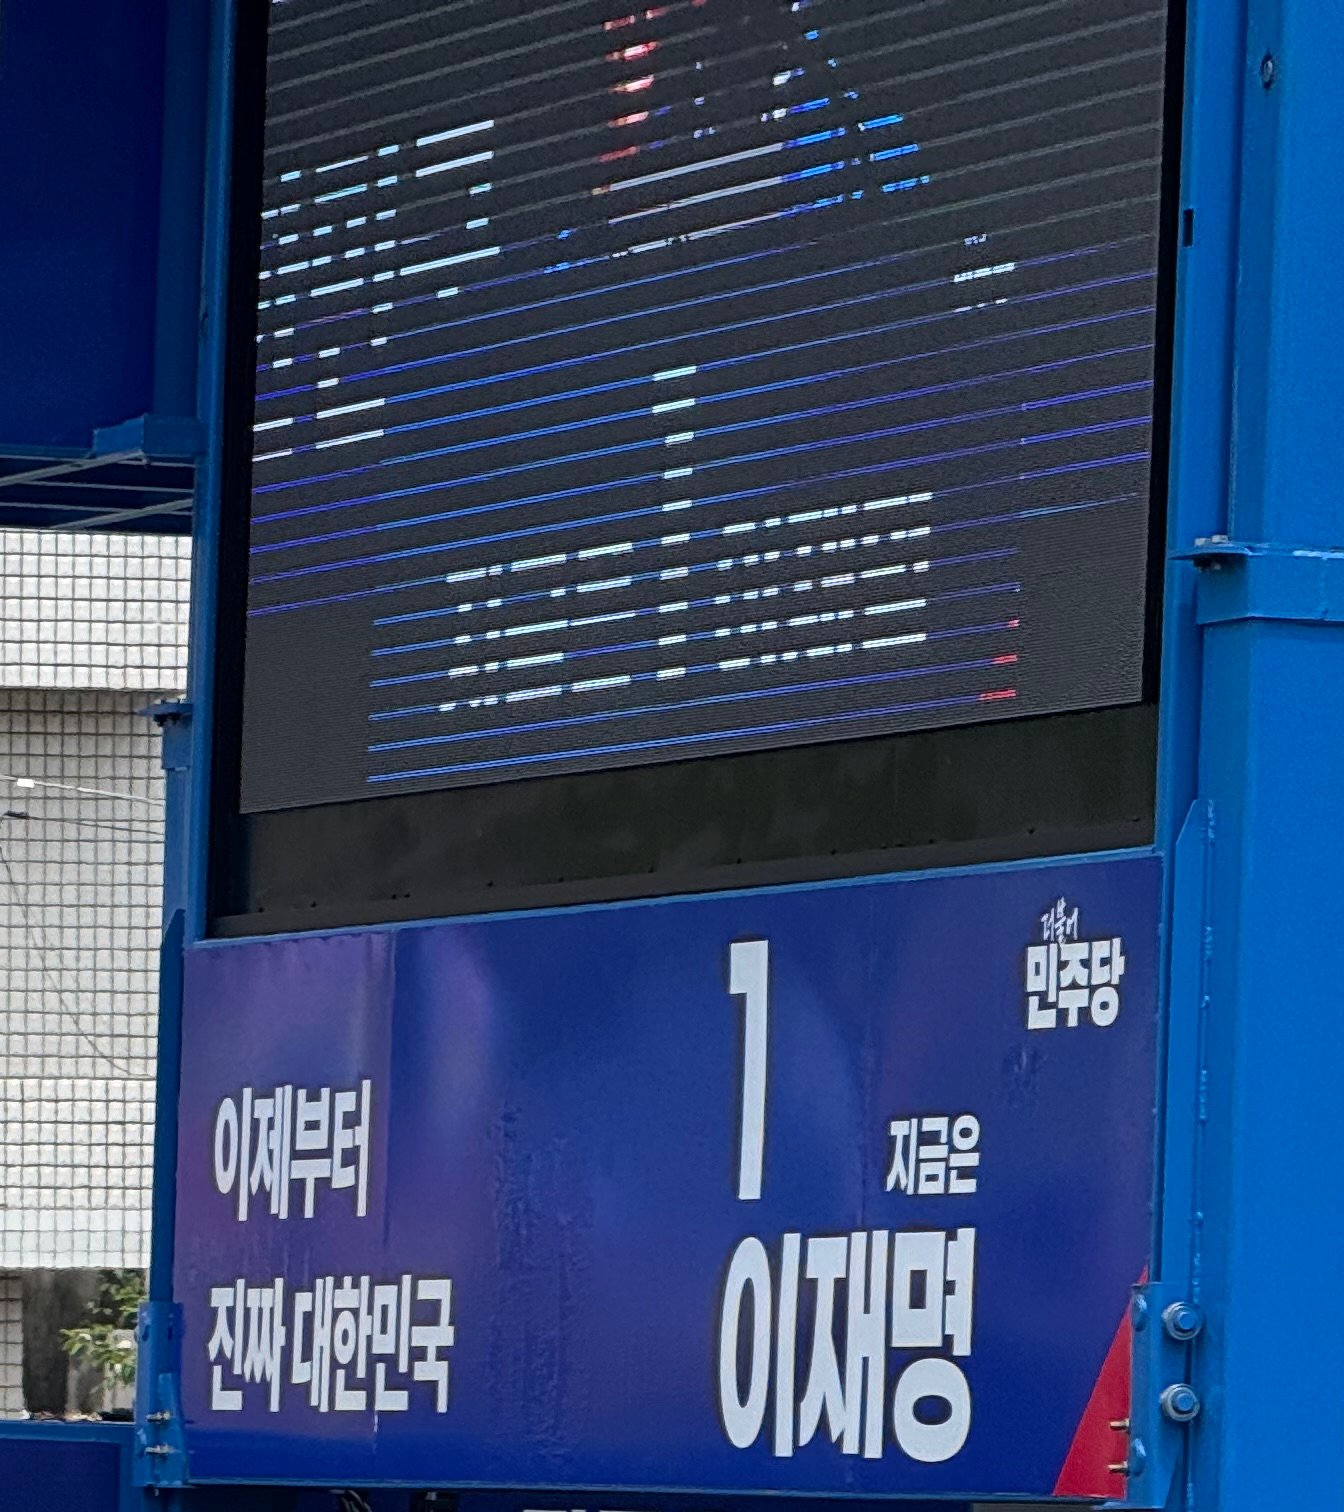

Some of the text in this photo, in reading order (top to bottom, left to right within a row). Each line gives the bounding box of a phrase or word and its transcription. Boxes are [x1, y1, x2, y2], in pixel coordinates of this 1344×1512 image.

[1026, 937, 1126, 1030] 민주당
[728, 941, 769, 1200] 1
[214, 1080, 371, 1223] 이제부터
[886, 1115, 980, 1195] 지금은
[208, 1276, 456, 1413] 진짜 대한민국
[720, 1226, 977, 1463] 이재명
